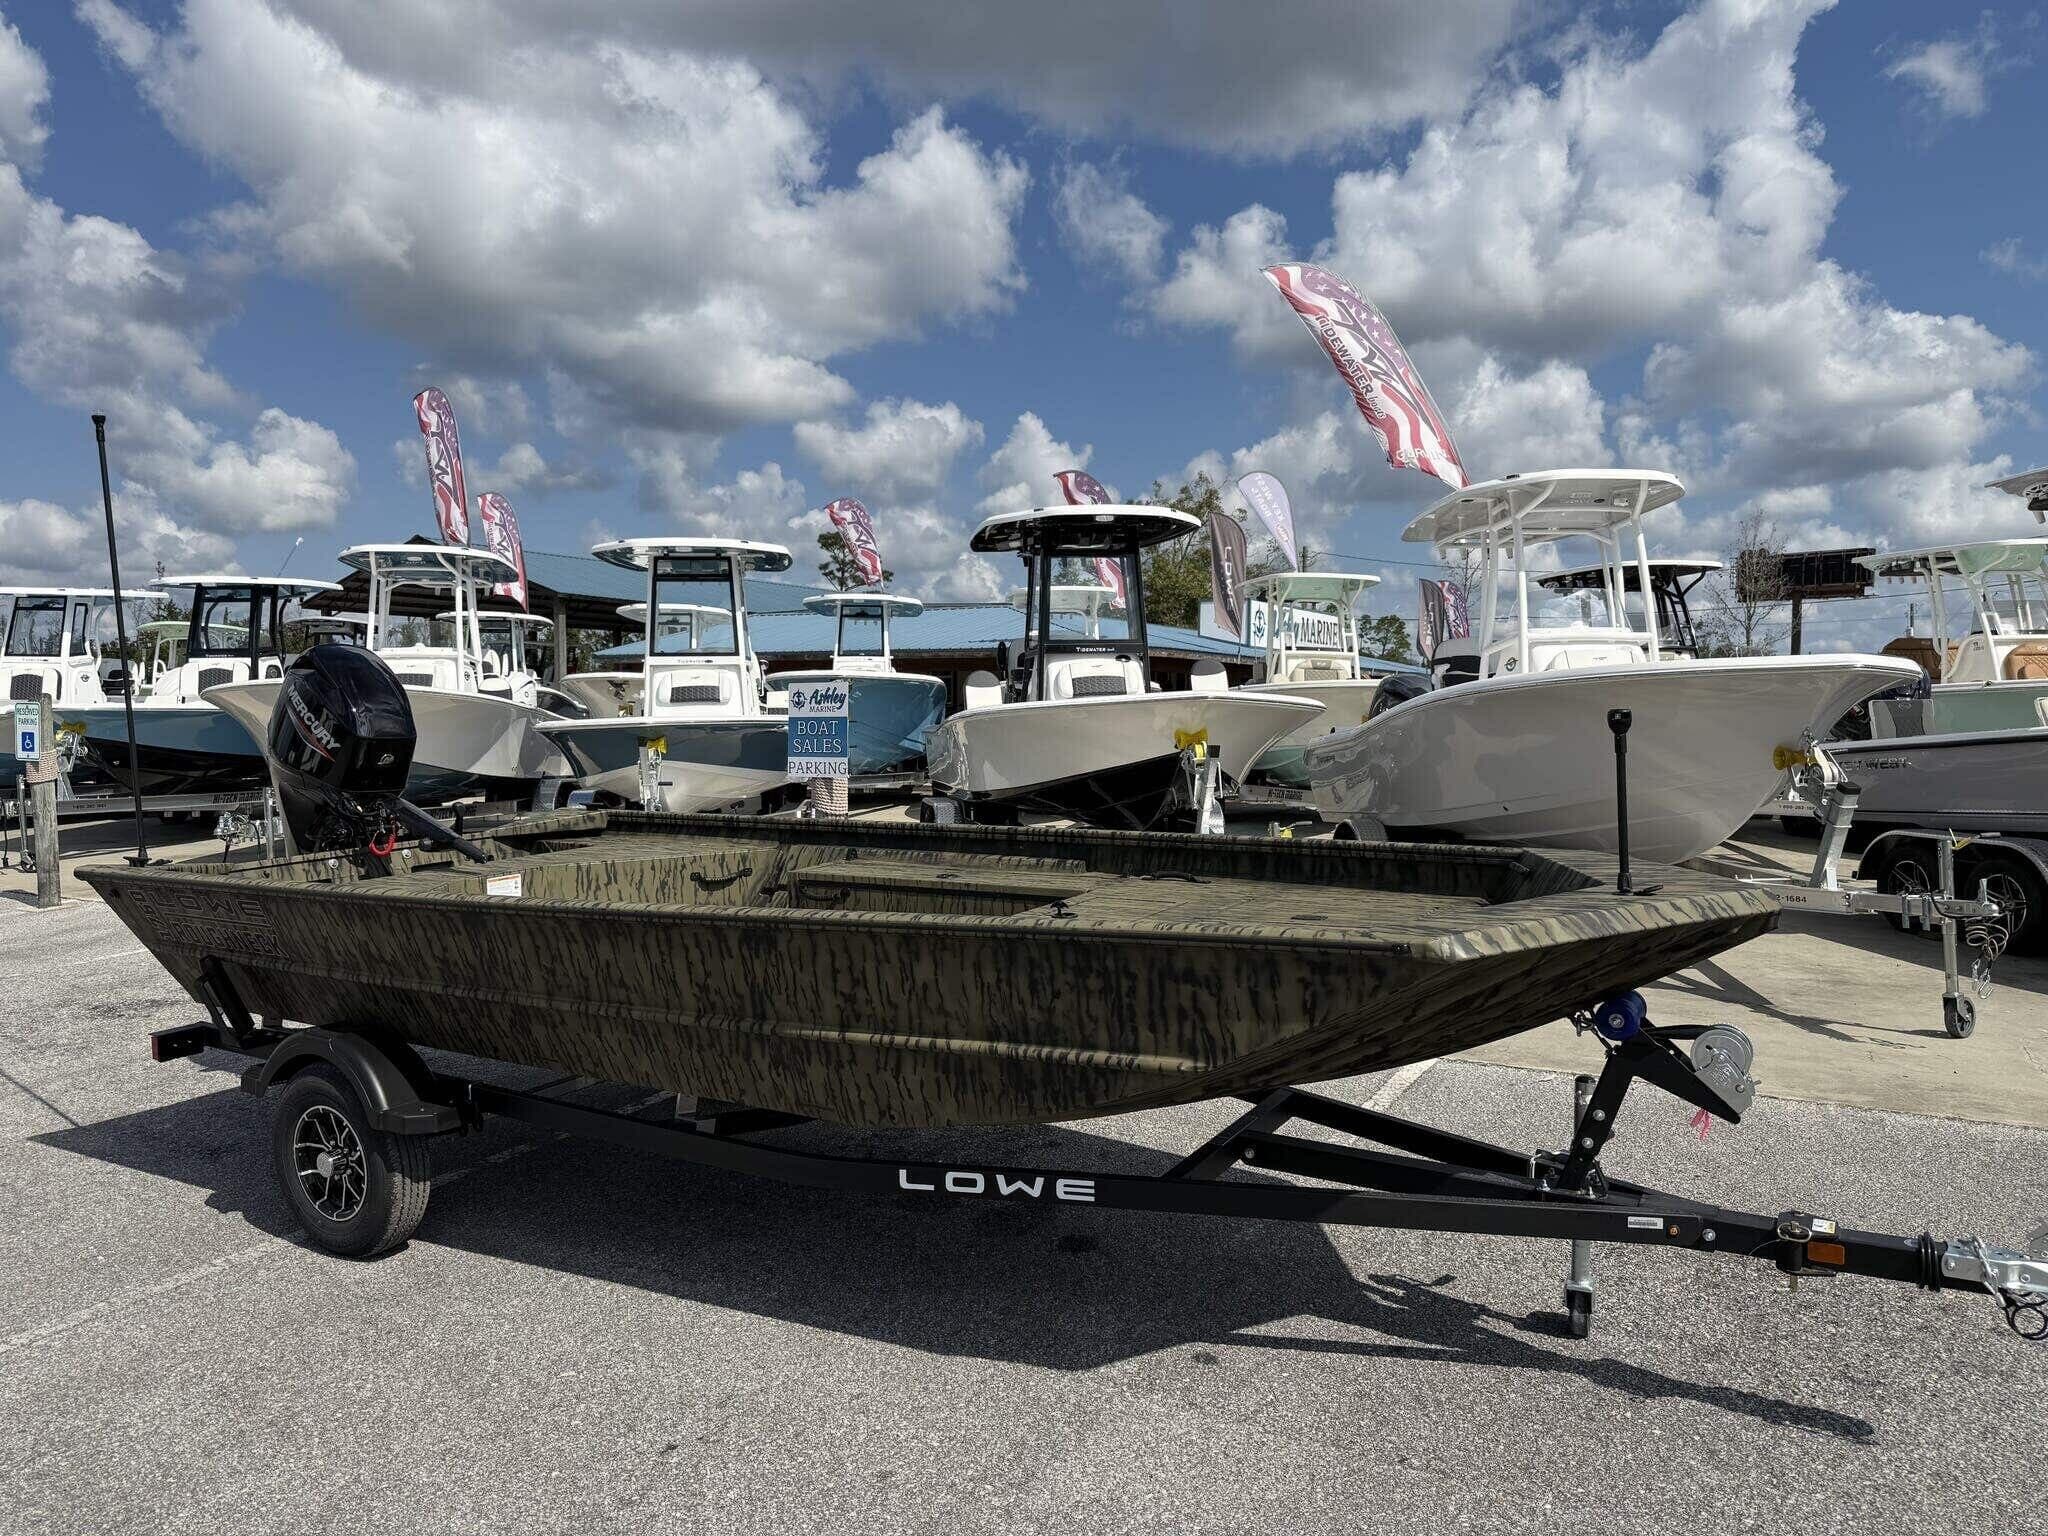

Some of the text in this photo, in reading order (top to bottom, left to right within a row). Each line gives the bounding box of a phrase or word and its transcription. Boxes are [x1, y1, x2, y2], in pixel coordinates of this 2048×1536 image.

[1315, 313, 1375, 396] TIDEWATER
[809, 686, 847, 710] Ashley
[286, 684, 341, 750] MERCURY
[797, 720, 838, 735] BOAT
[793, 738, 842, 753] SALES
[788, 761, 847, 775] PARKING
[899, 1169, 1096, 1202] LOWE
